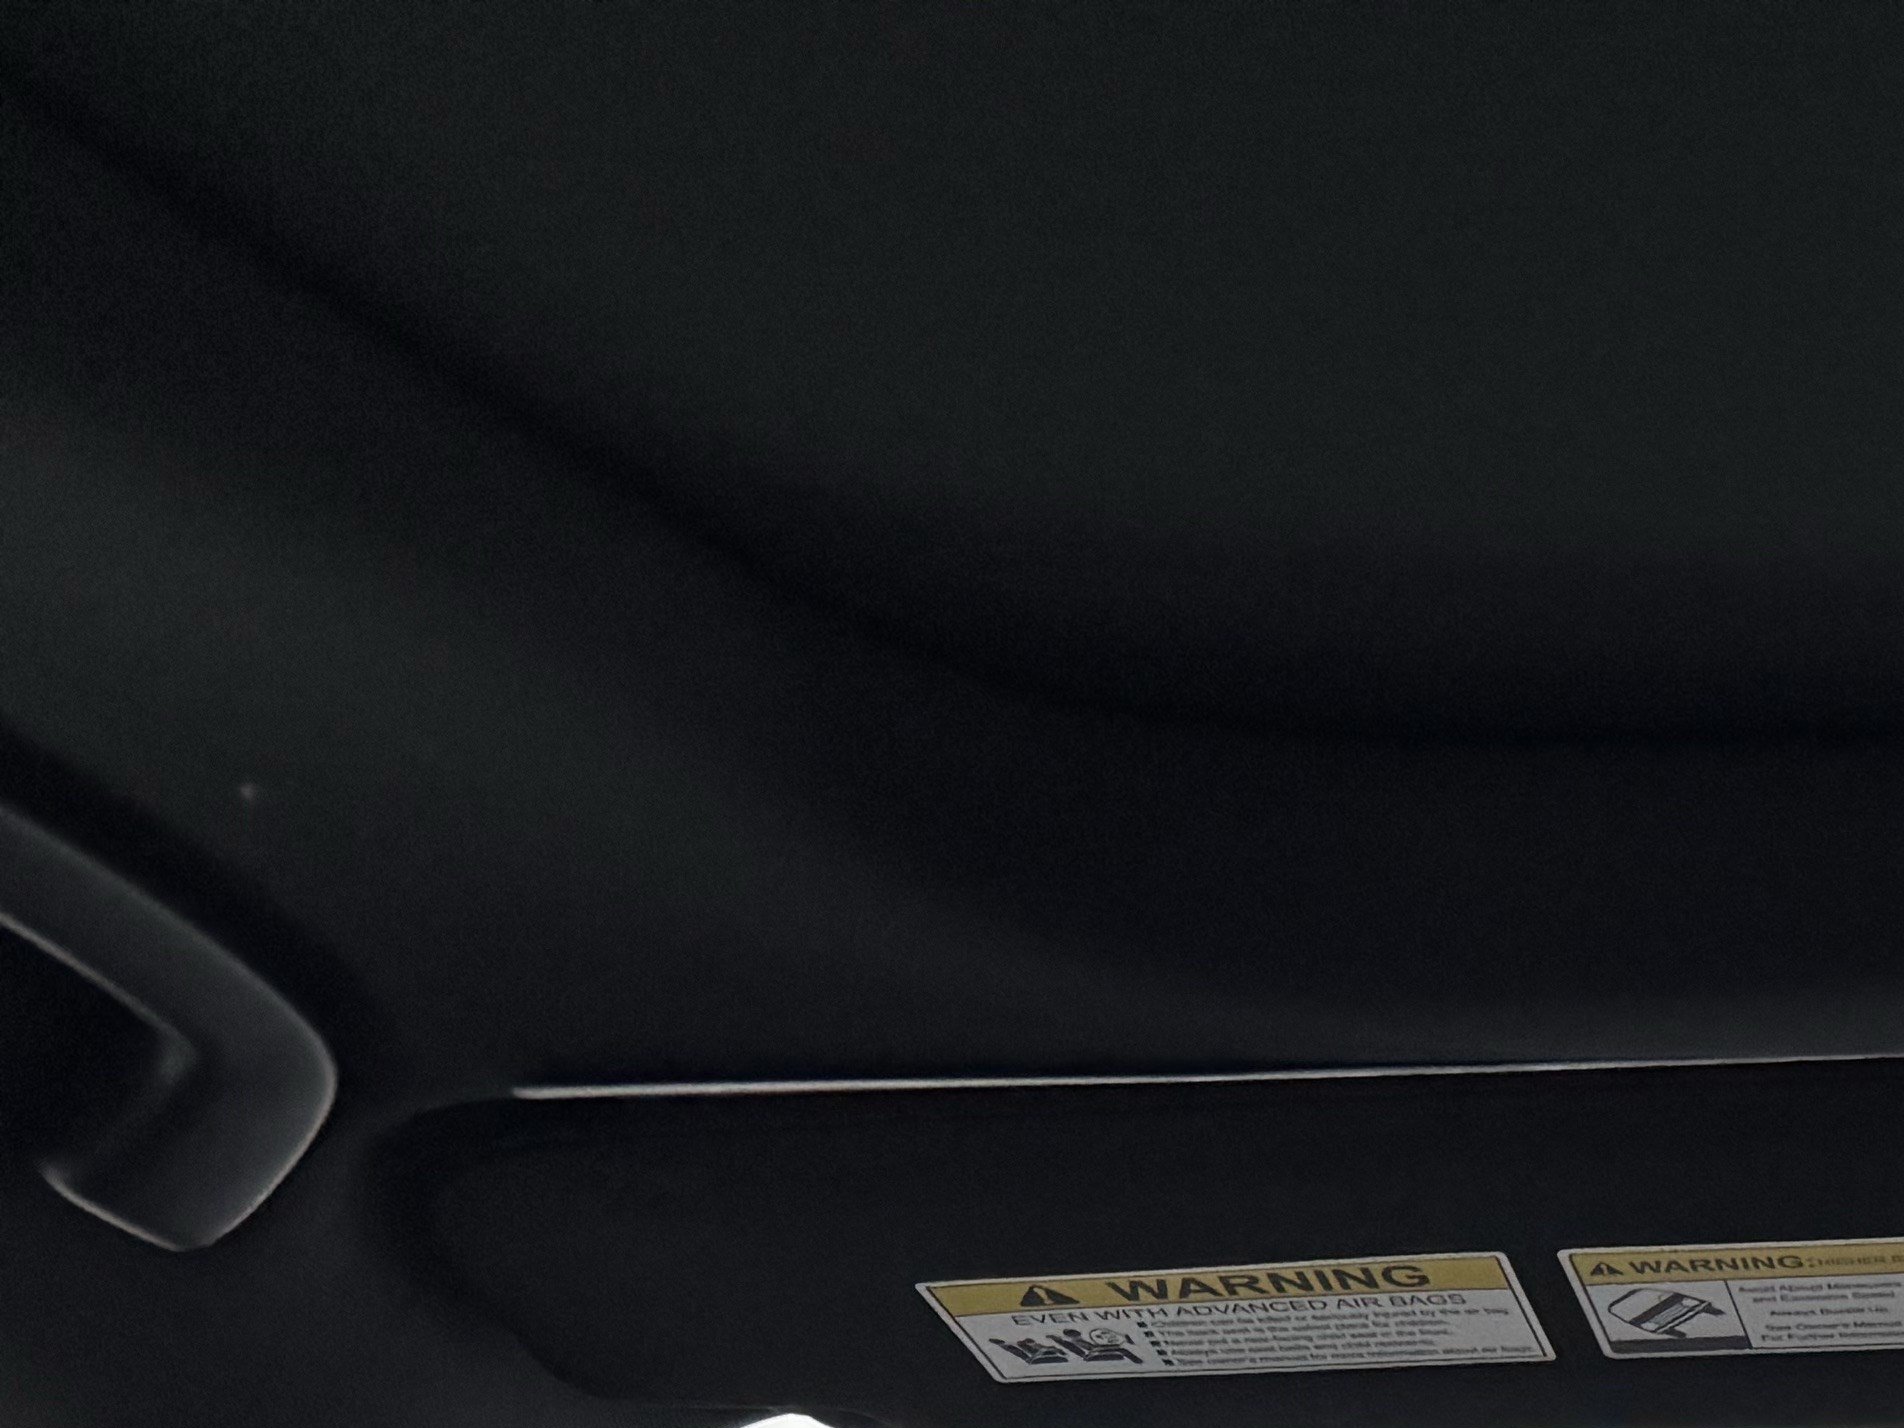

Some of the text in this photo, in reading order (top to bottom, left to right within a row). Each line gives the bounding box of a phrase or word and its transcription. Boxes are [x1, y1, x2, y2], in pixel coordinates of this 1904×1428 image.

[1105, 1264, 1431, 1303] WARNING
[1012, 1312, 1090, 1328] EVEN
[1094, 1304, 1171, 1323] WITH
[1173, 1299, 1328, 1319] ADVANCED
[1334, 1296, 1383, 1311] AIR
